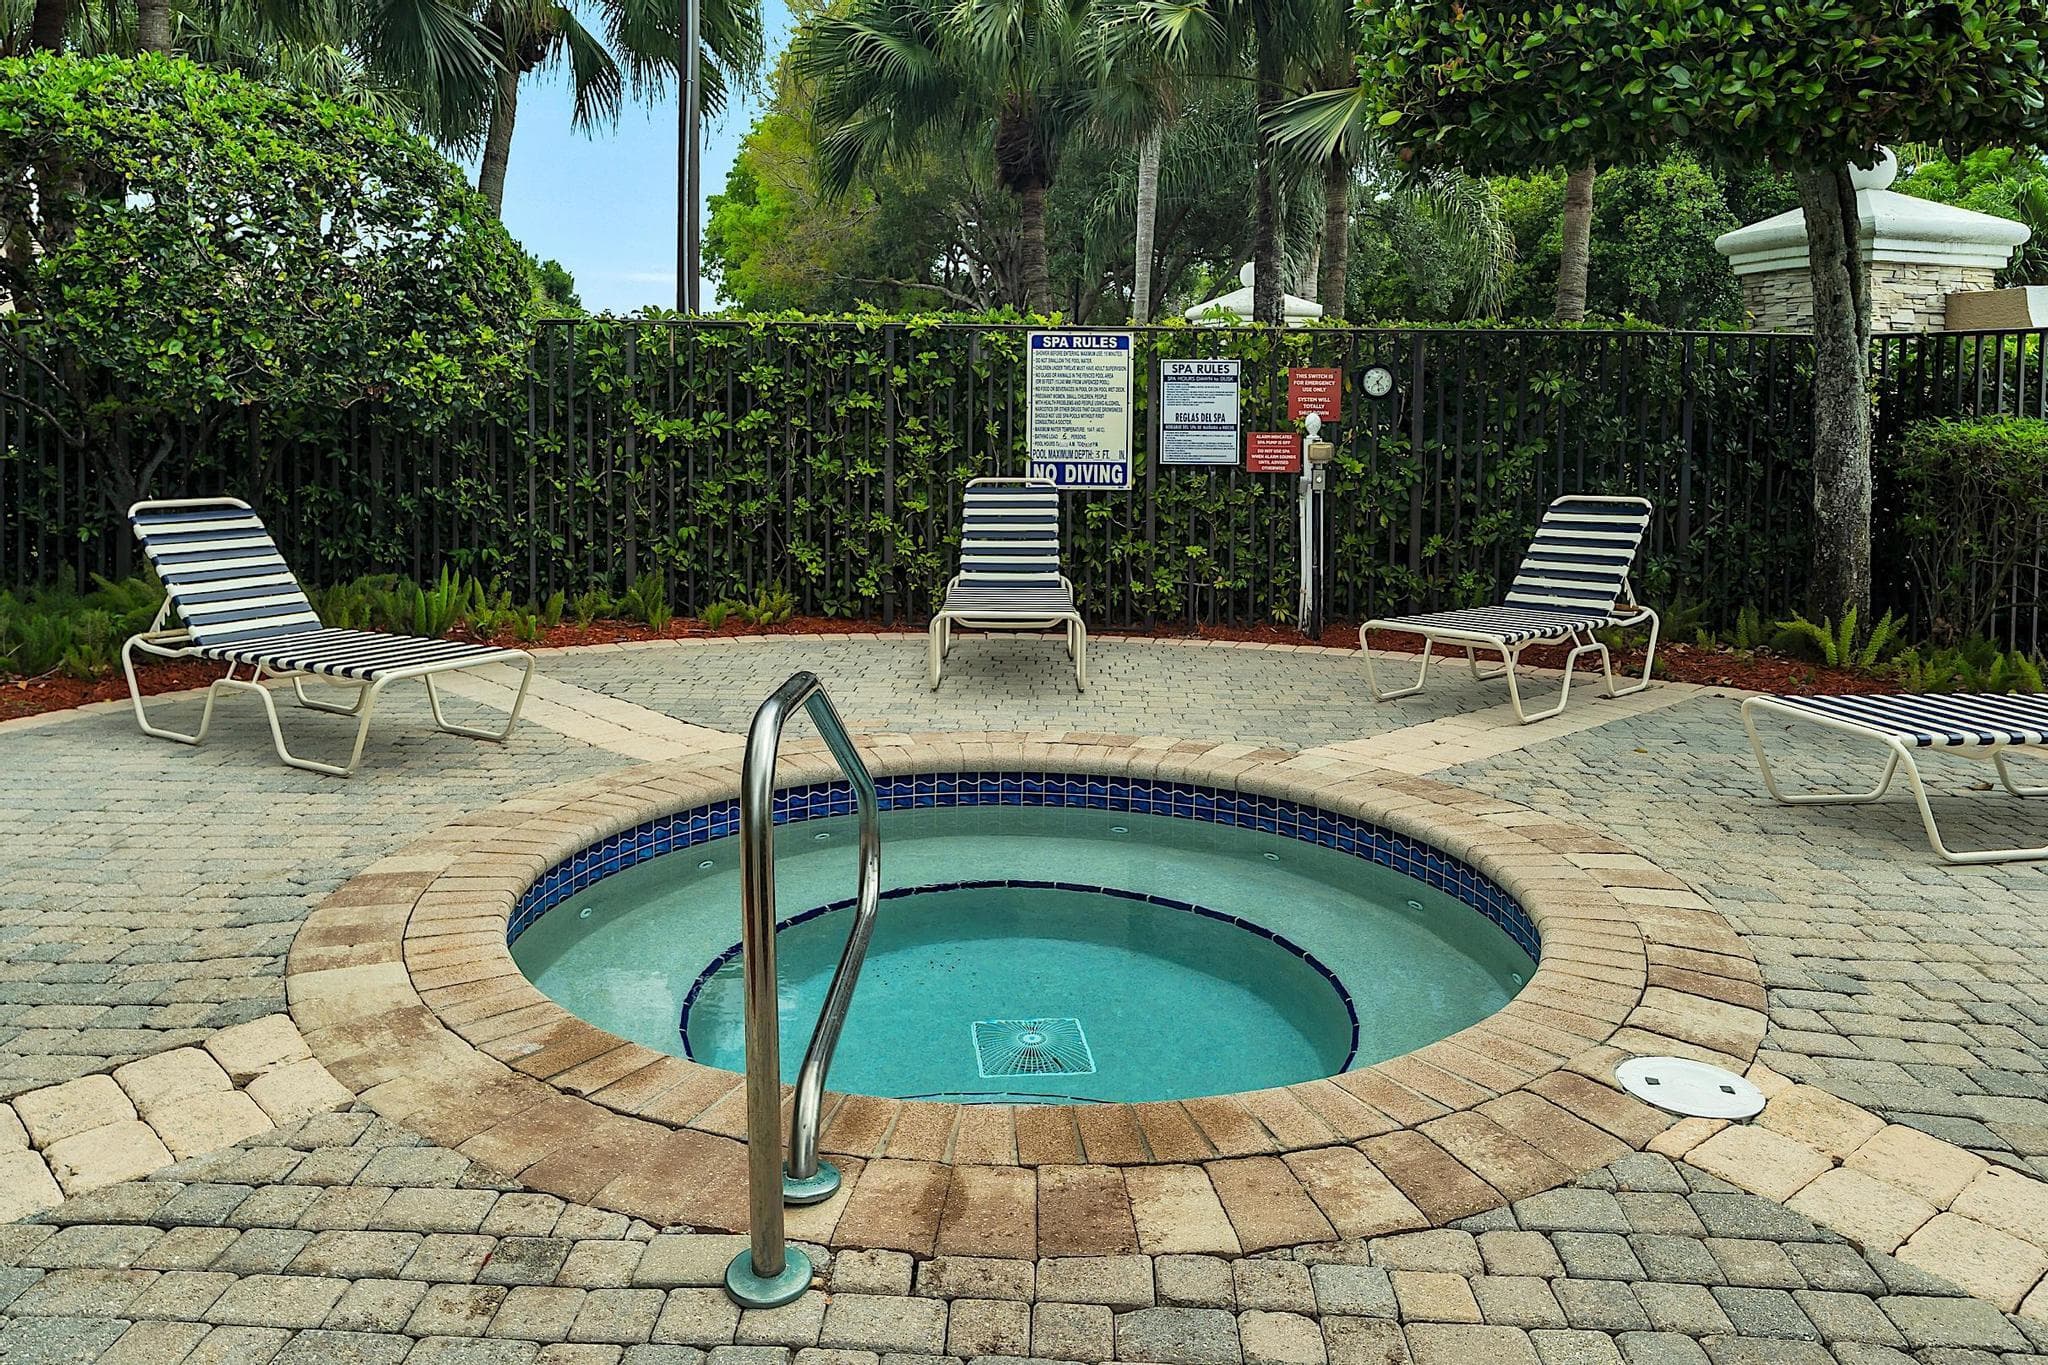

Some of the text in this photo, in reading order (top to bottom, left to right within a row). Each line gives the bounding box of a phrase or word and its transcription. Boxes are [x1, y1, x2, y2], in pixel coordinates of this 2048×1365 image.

[1042, 336, 1118, 348] SPA RULES
[1172, 363, 1230, 374] SPA RULES
[1175, 412, 1226, 422] REGLAS DEL SPA
[1033, 449, 1046, 459] POOL
[1048, 449, 1073, 459] MAXIMUM
[1033, 463, 1123, 484] NO DIVING
